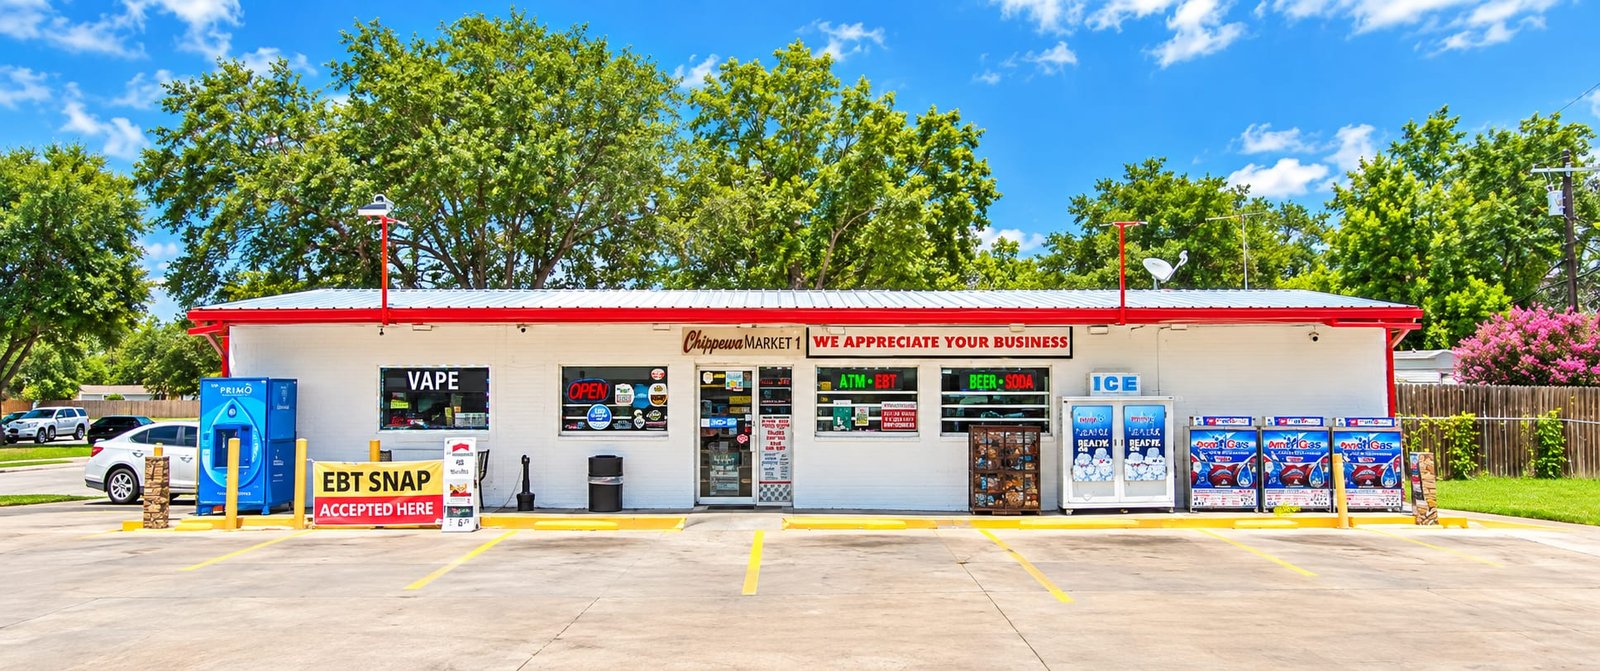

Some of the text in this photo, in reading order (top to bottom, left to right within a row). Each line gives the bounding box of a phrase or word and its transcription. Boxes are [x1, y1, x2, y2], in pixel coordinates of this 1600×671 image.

[682, 330, 801, 355] Chippewa MARKET 1
[813, 335, 1068, 349] WE APPRECIATE YOUR BUSINESS
[407, 371, 459, 391] VAPE
[839, 373, 897, 389] ATM EBT
[968, 374, 1035, 389] BEER SODA
[1093, 376, 1138, 391] ICE
[569, 382, 609, 400] OPEN
[323, 470, 431, 493] EBT SNAP
[319, 502, 393, 517] ACCEPTED
[396, 502, 434, 516] HERE
